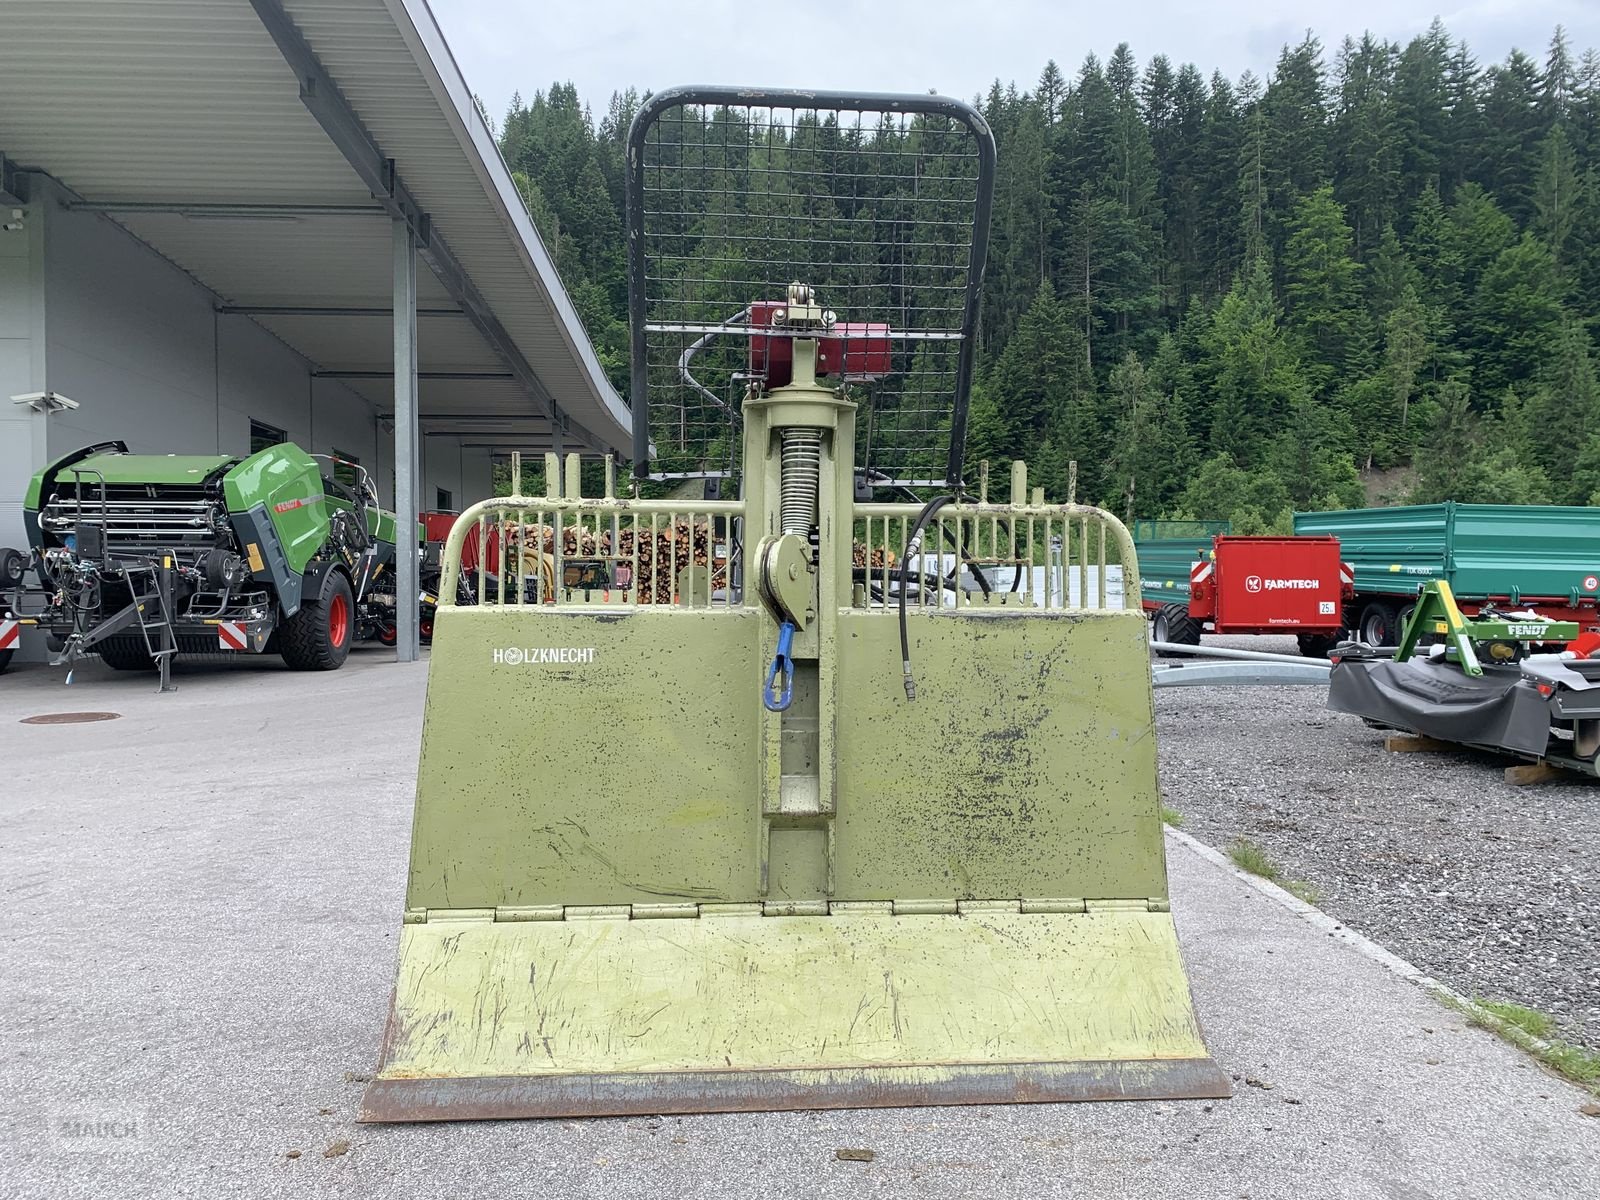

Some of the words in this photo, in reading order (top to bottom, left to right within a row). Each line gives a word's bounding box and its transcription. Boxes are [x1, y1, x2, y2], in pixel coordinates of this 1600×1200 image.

[277, 499, 300, 511] FENDT
[1264, 579, 1319, 590] FARMTECH
[1507, 625, 1549, 635] FENDT
